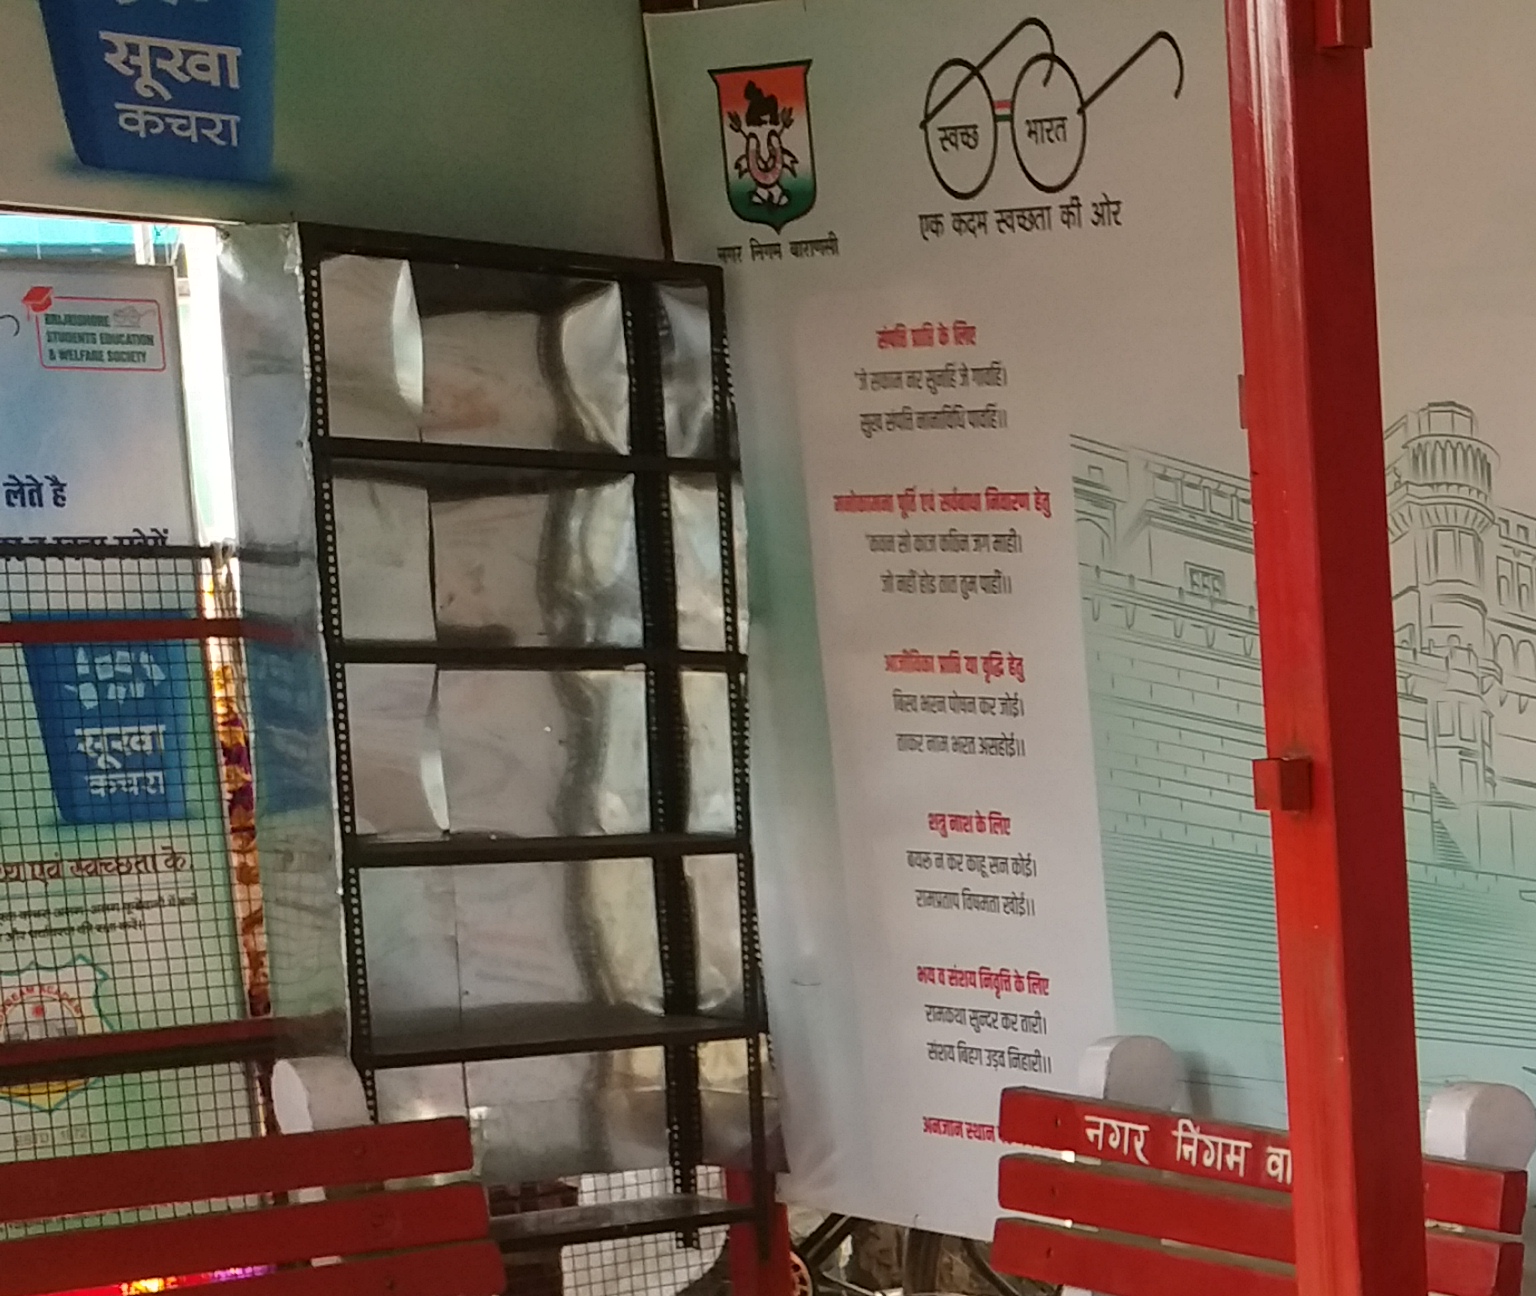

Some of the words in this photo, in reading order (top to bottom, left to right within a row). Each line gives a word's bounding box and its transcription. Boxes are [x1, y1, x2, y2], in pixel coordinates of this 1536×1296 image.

[99, 30, 242, 100] सूखा
[114, 102, 240, 147] कचरा
[938, 124, 980, 152] स्वच्छ
[1025, 116, 1068, 145] भारत
[918, 213, 944, 241] एक
[951, 210, 988, 238] कदम
[994, 206, 1052, 234] स्वच्छता
[1059, 195, 1082, 230] की
[1091, 193, 1122, 227] ओर
[717, 246, 742, 263] नगर
[749, 237, 782, 261] निगम
[789, 231, 839, 258] वाराणसी
[100, 332, 155, 346] EDUCATION
[58, 350, 104, 362] WELFARE
[107, 350, 147, 363] SOCIETY
[3, 474, 43, 508] लेते
[75, 724, 166, 770] सूखा
[84, 771, 165, 798] कचरा
[948, 814, 973, 834] नाश
[974, 810, 986, 833] के
[988, 811, 1011, 835] लिए
[161, 844, 188, 872] के
[946, 852, 964, 872] कर
[917, 965, 936, 984] भय
[937, 967, 946, 985] व
[947, 965, 977, 988] संशय
[978, 966, 1012, 999] निवृत्ति
[1013, 969, 1025, 993] के
[1026, 971, 1050, 996] लिए
[969, 1008, 999, 1034] सुन्दर
[1000, 1011, 1019, 1032] कर
[922, 1116, 964, 1139] अनजान
[964, 1120, 996, 1143] स्थान
[1084, 1114, 1150, 1165] नगर
